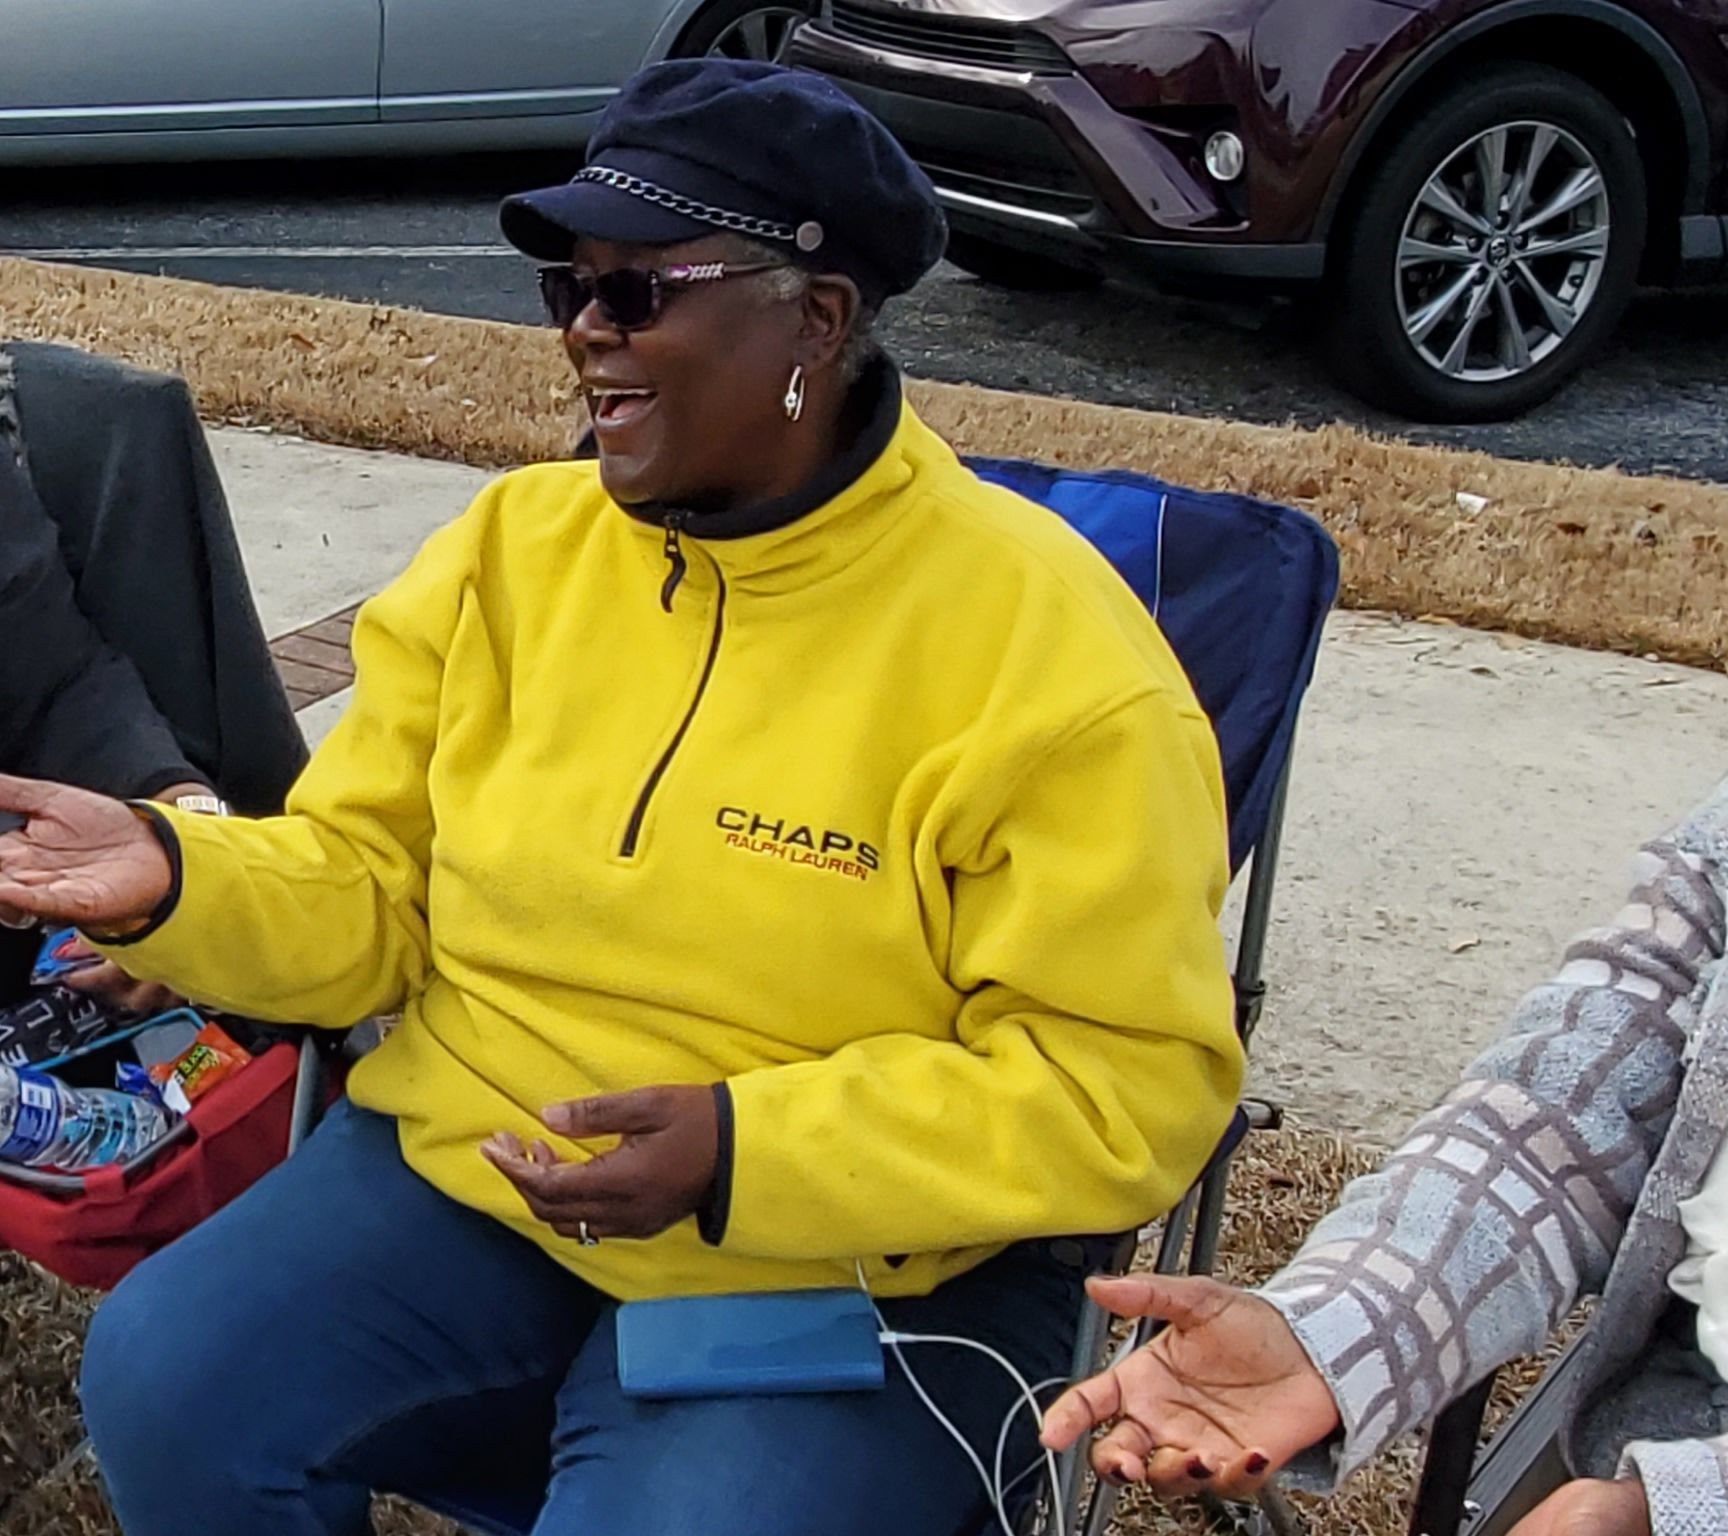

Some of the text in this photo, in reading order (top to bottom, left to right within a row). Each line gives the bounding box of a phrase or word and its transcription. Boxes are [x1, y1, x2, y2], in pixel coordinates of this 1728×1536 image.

[715, 806, 880, 871] CHAPS
[725, 833, 869, 881] RALPH LAUREN
